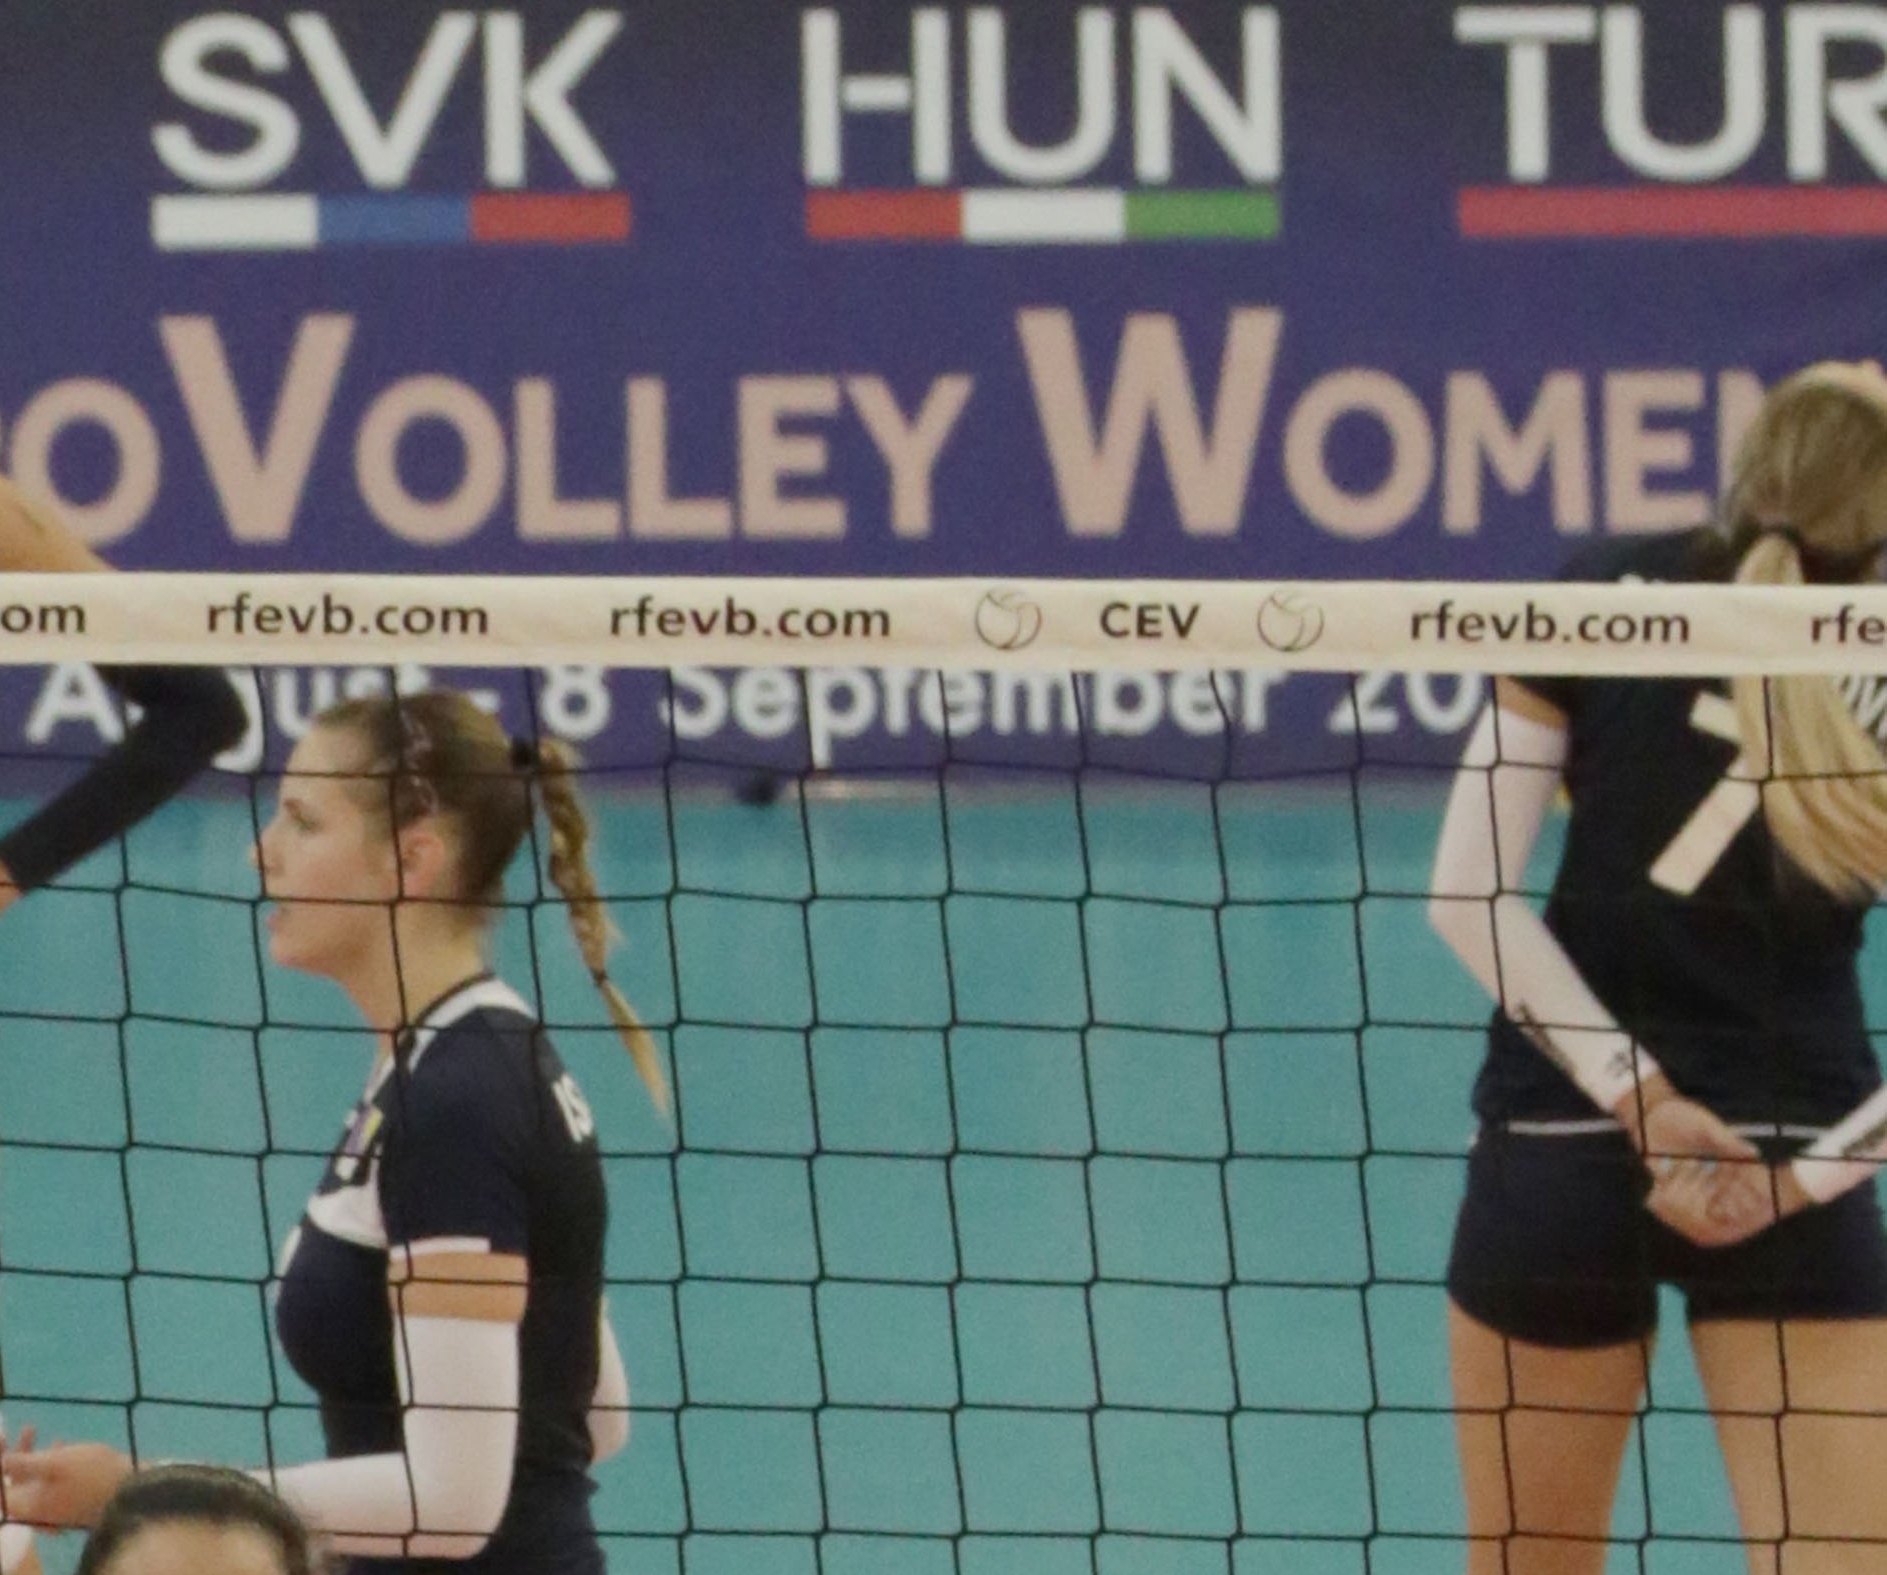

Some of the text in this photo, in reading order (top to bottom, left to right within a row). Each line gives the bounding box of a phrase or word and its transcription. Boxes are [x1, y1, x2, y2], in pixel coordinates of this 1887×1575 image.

[150, 9, 625, 190] SVK
[801, 6, 1283, 186] HUN
[1454, 4, 1887, 184] TUR
[206, 591, 489, 637] rfevb.com
[609, 594, 892, 640] rfevb.com
[1098, 600, 1201, 641] CEV
[1410, 600, 1691, 645] rfevb.com
[540, 663, 612, 740] 8
[656, 664, 1279, 770] September
